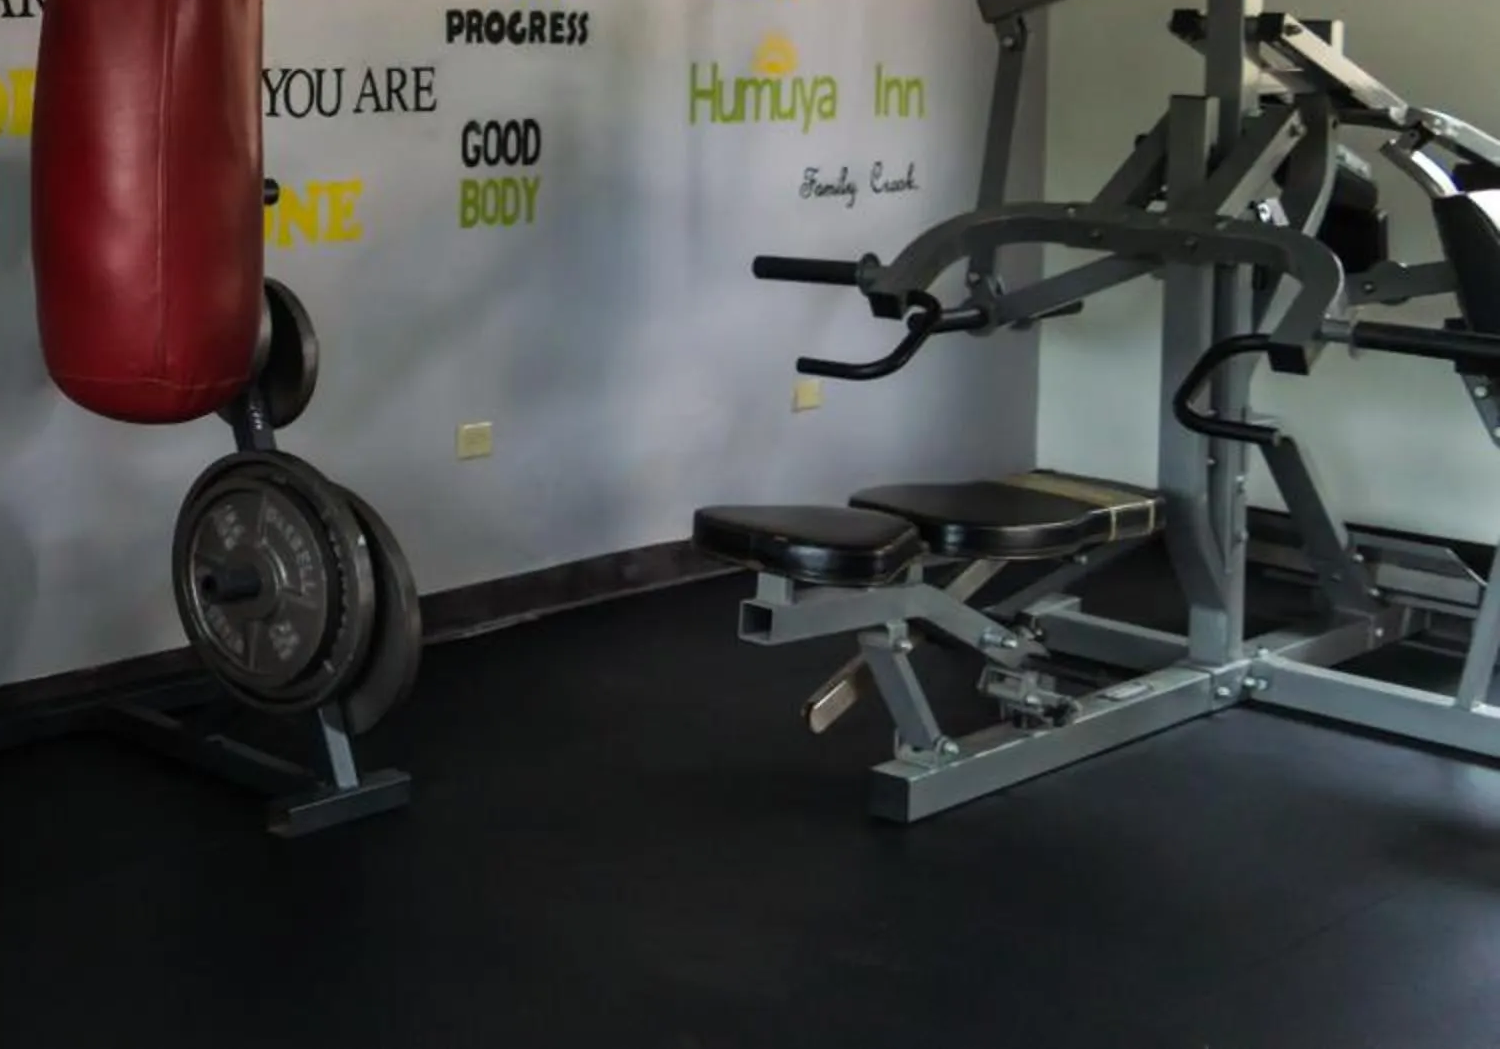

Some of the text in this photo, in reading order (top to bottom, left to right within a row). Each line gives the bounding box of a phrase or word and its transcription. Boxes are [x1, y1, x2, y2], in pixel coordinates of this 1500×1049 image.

[445, 8, 590, 46] PROGRESS
[262, 66, 438, 118] YOU ARE
[689, 61, 925, 135] Humuya Inn
[461, 119, 542, 168] GOOD
[459, 175, 542, 229] BODY
